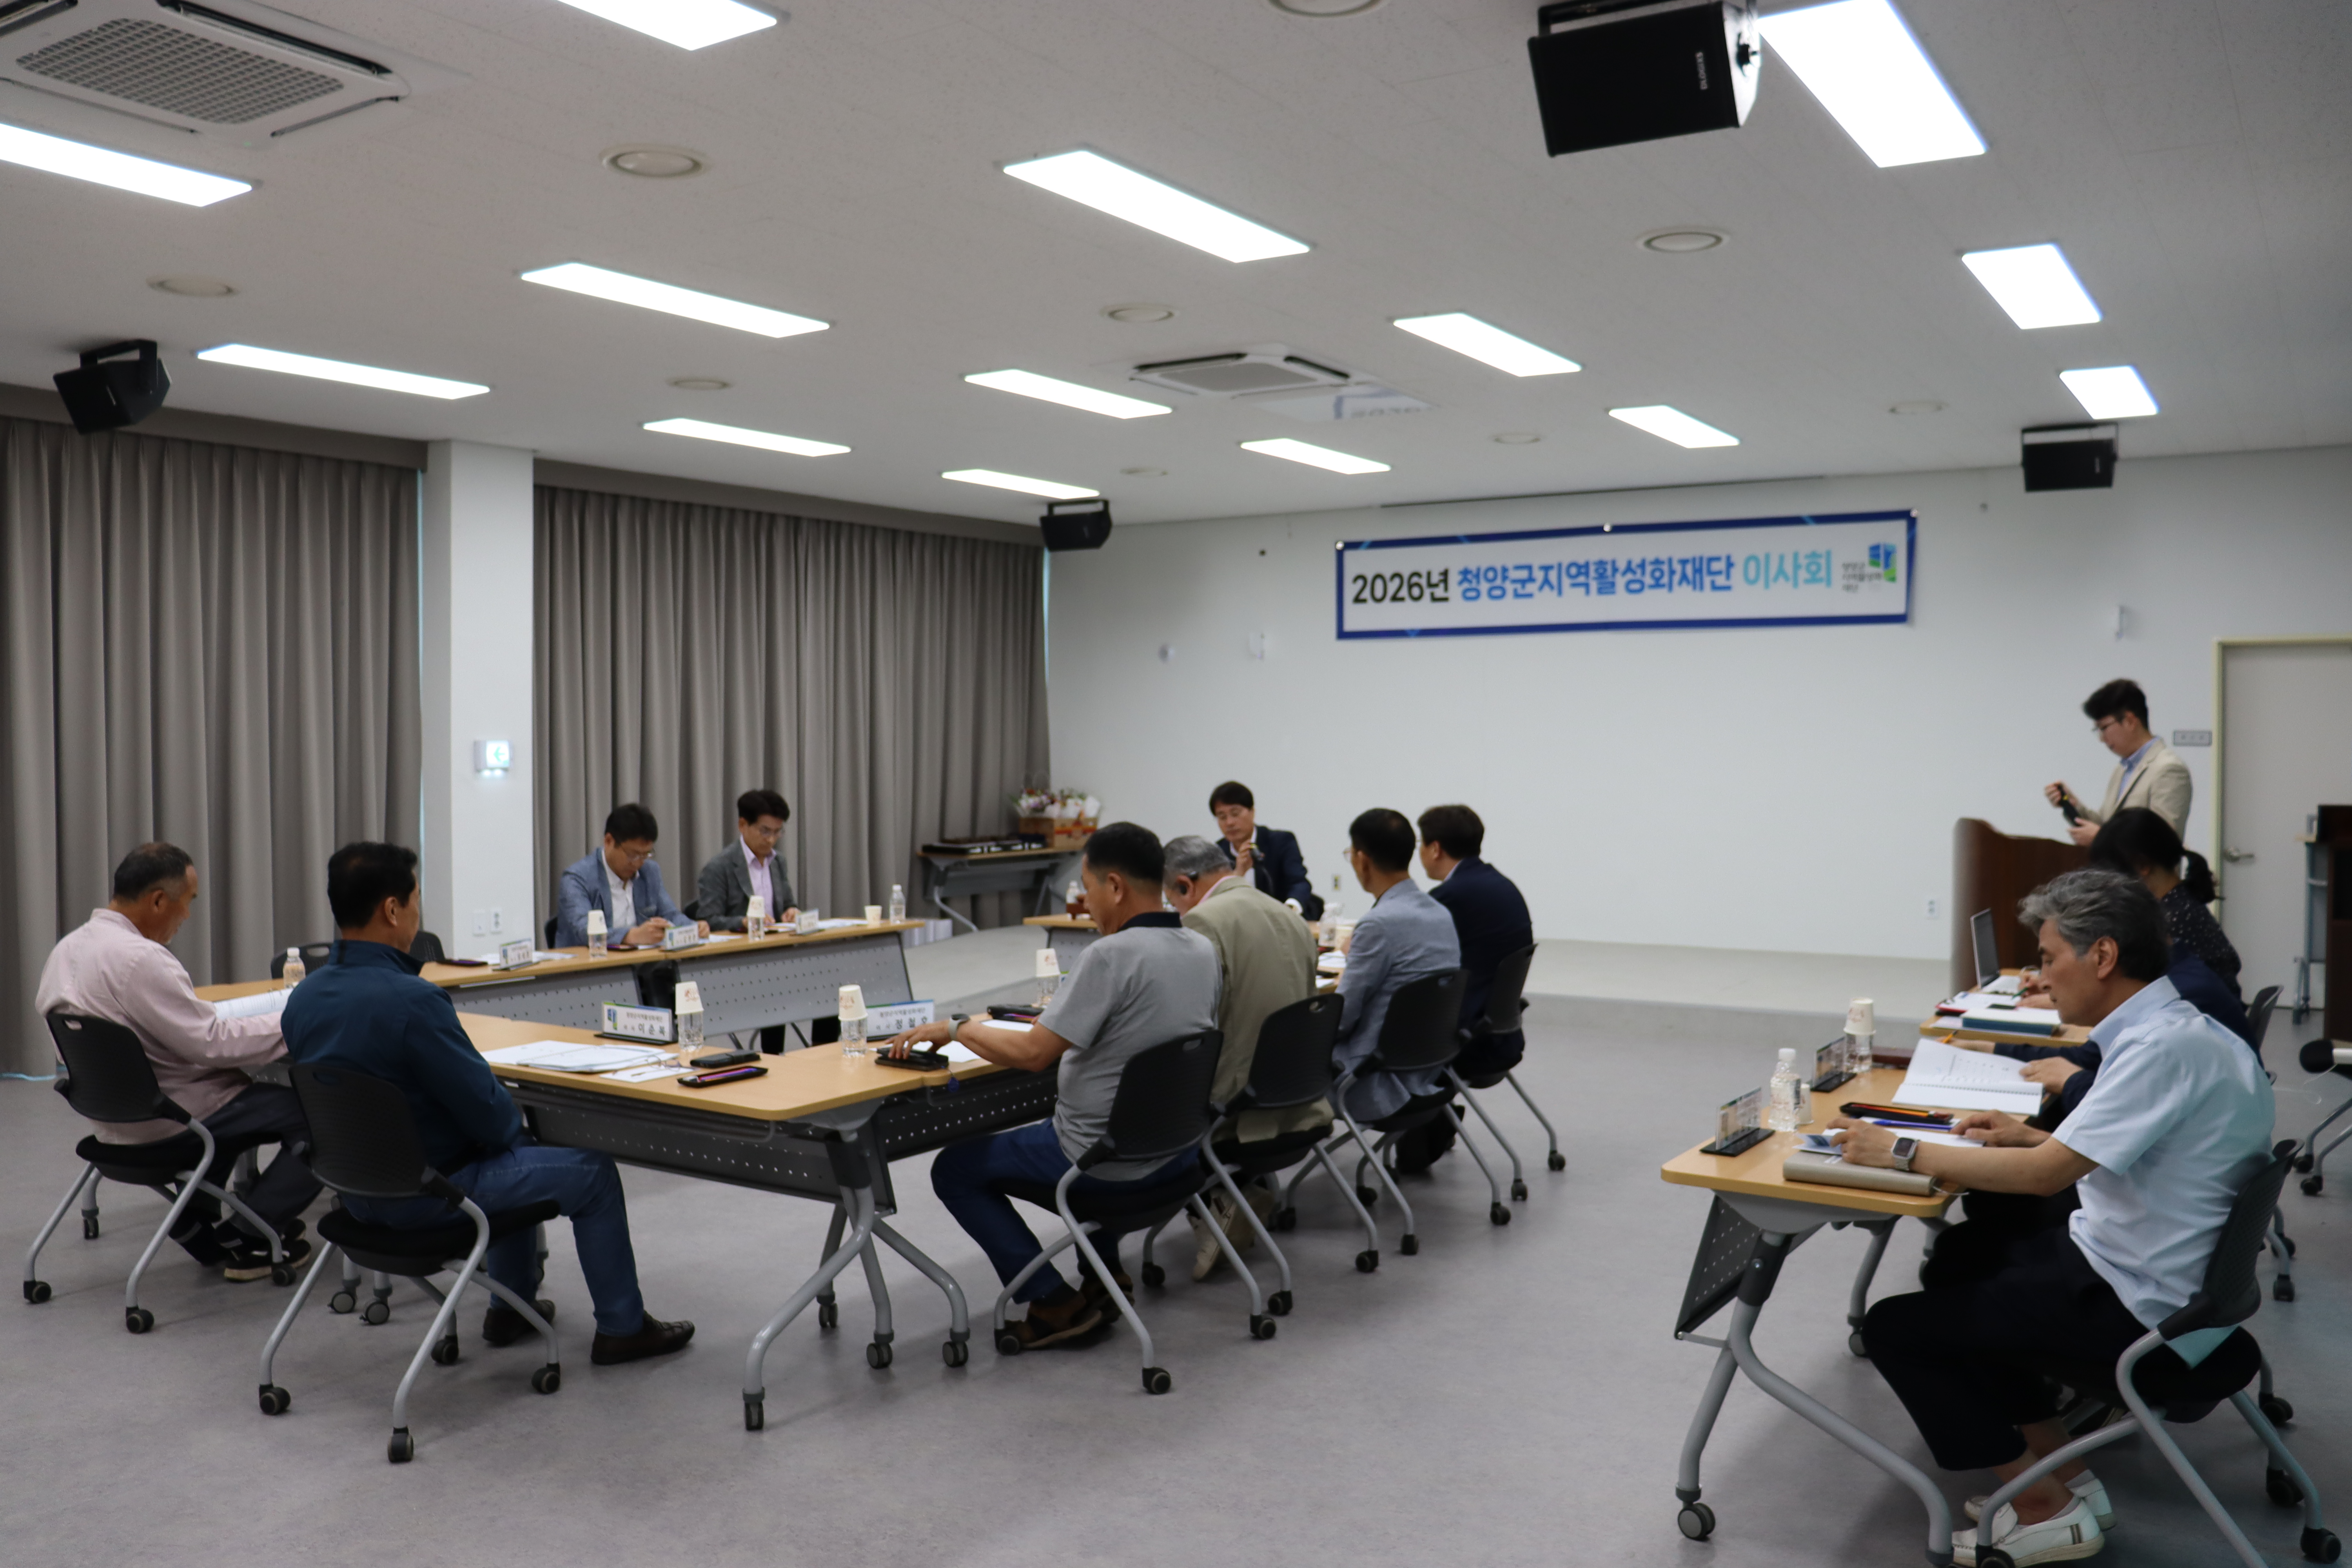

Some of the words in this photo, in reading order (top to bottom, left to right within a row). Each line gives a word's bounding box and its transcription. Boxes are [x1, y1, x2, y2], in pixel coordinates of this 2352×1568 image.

[1352, 568, 1449, 603] 2026년
[1457, 554, 1735, 602] 청양군지역활성화재단
[1742, 549, 1832, 590] 이사회
